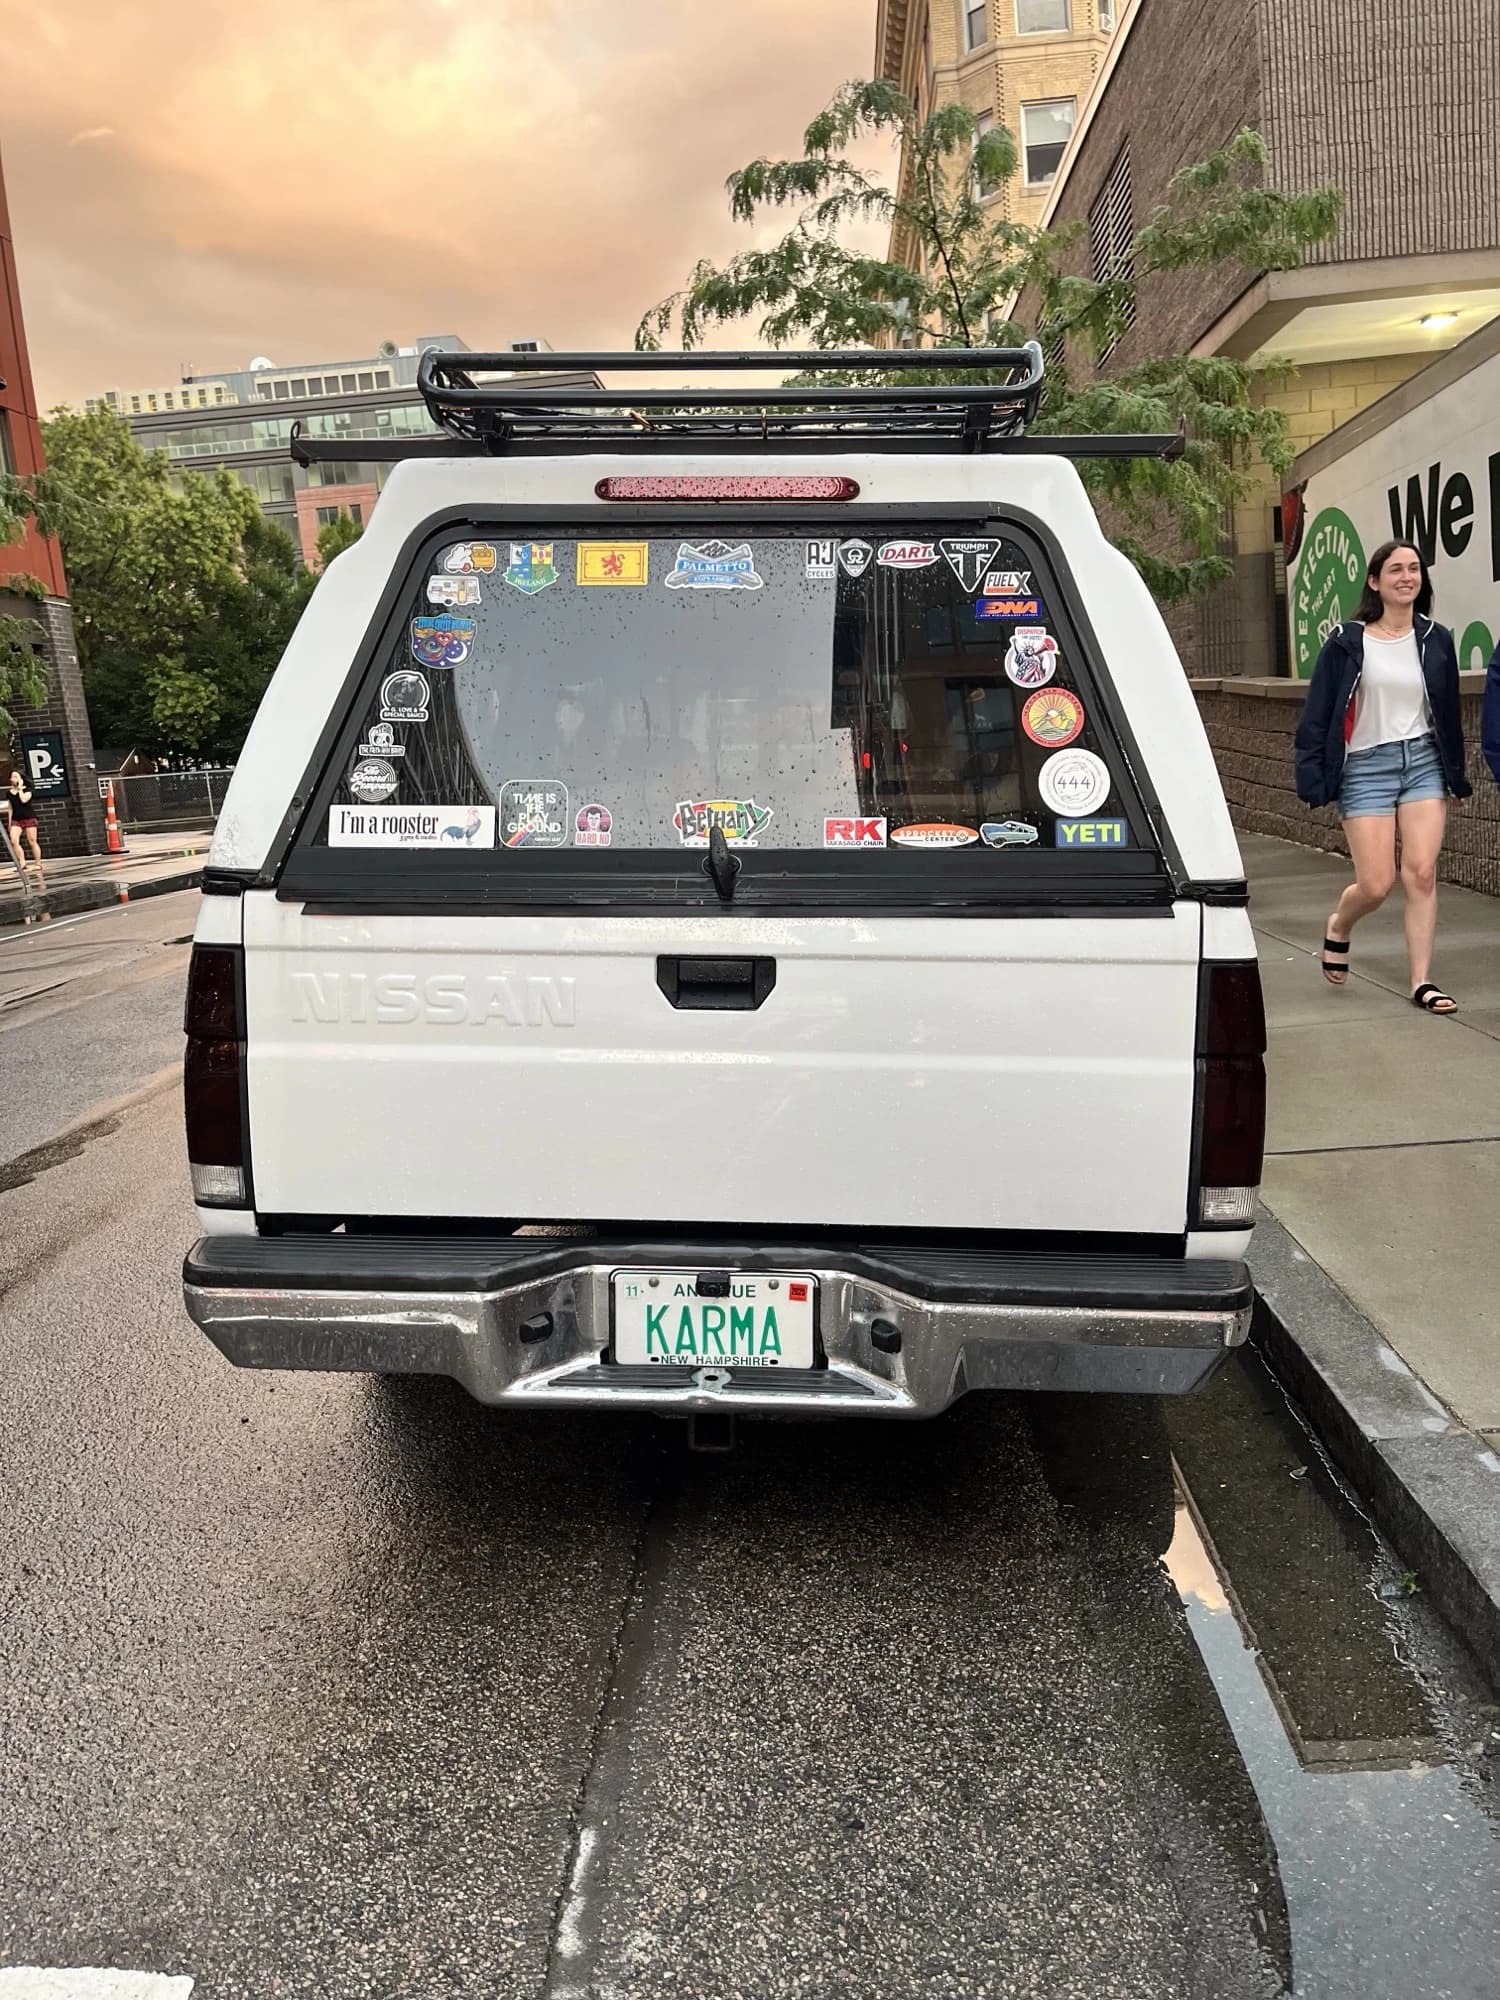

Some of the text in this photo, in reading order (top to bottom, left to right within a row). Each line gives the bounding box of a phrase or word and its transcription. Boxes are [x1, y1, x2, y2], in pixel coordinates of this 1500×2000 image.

[1388, 461, 1474, 568] We
[883, 546, 928, 560] DART
[950, 543, 989, 551] TRIUMPH
[682, 561, 747, 573] PALMETTO
[514, 577, 546, 586] IRELAND
[1298, 525, 1359, 663] PERFECTING
[1312, 567, 1336, 616] THE ART
[983, 601, 1038, 614] DNA
[28, 749, 52, 779] P
[1057, 775, 1091, 790] 444
[513, 793, 557, 804] TIME IS
[525, 803, 544, 813] THE
[340, 811, 439, 834] I'm a rooster
[507, 822, 560, 833] GROUND
[826, 820, 883, 840] RK
[1061, 823, 1120, 843] YETI
[290, 973, 577, 1027] NISSAN
[625, 1286, 638, 1296] 11
[674, 1284, 756, 1298] ANUE
[646, 1304, 782, 1355] KARMA
[661, 1355, 769, 1366] NEW HAMPSHIRE
